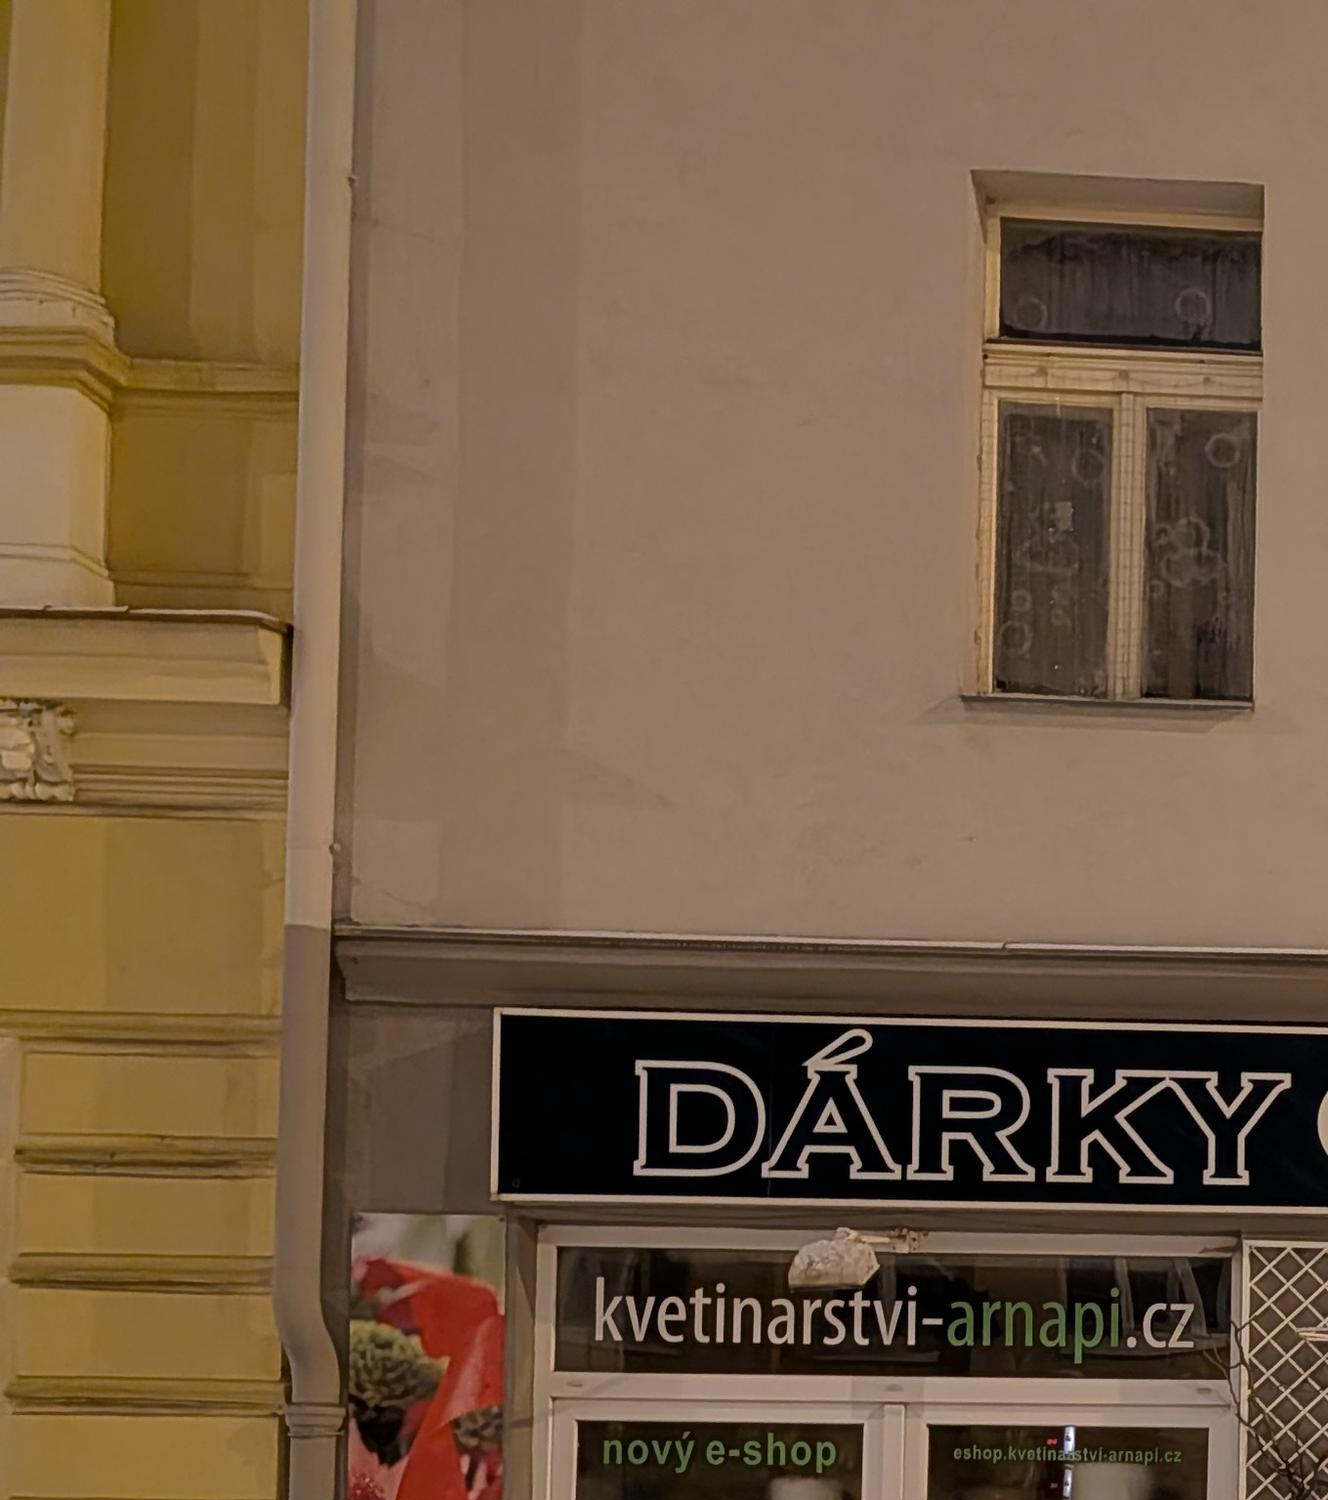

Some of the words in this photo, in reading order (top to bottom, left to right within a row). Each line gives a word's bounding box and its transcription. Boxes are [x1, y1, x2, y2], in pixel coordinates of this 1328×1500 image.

[634, 1028, 1292, 1186] DÁRKY
[594, 1276, 1196, 1365] kvetinarstvi-arnapi.cz
[602, 1430, 694, 1474] nový
[706, 1433, 837, 1476] e-shop
